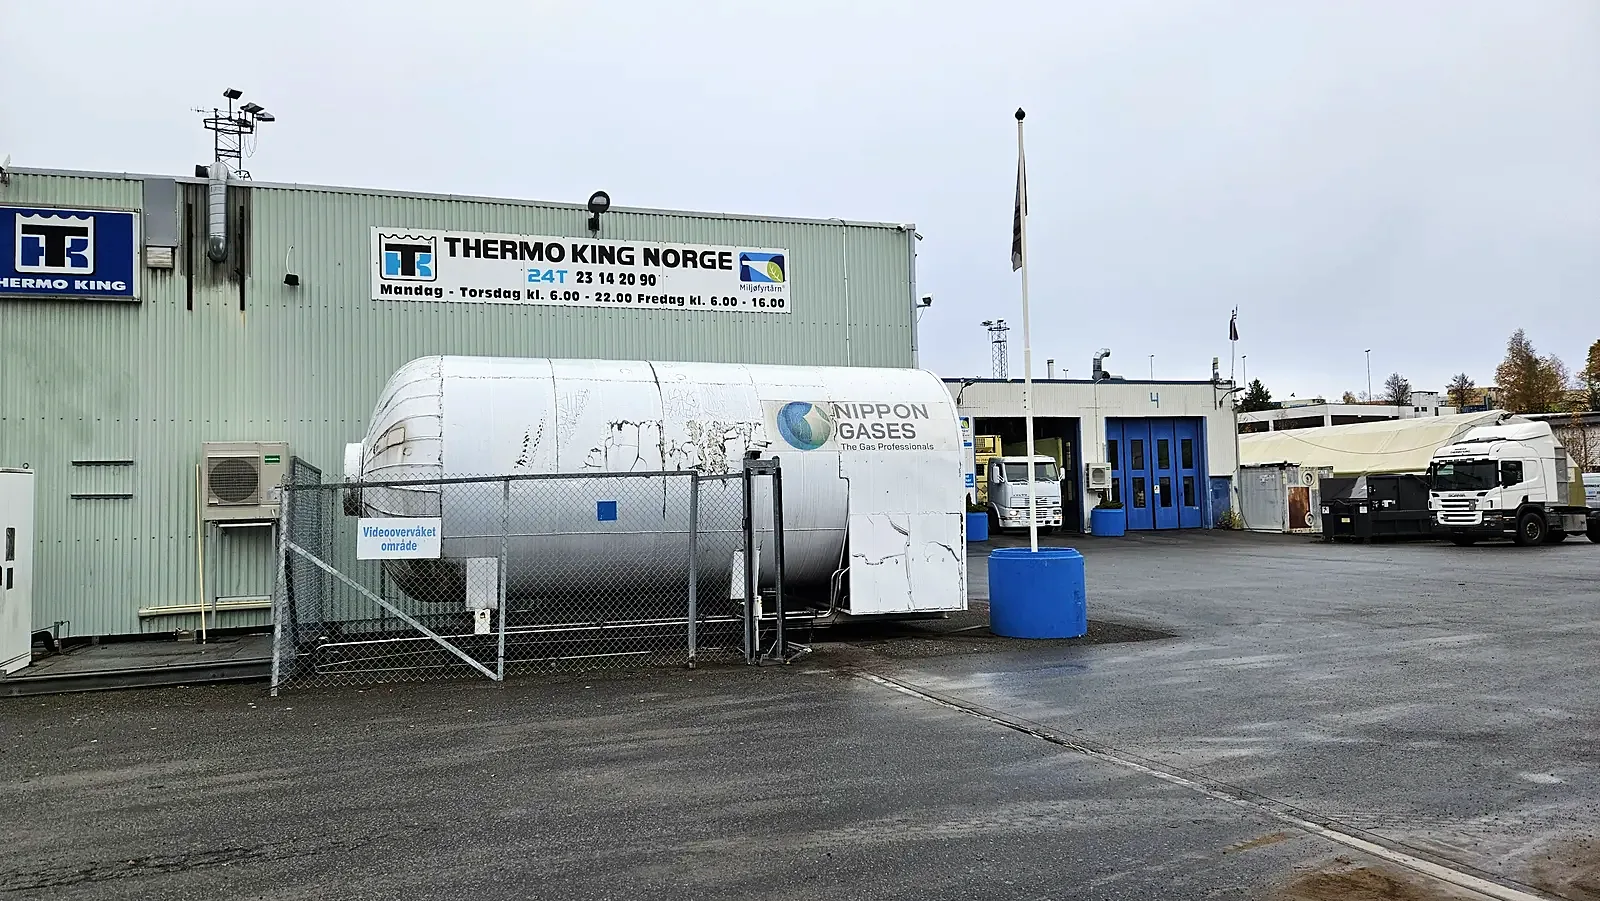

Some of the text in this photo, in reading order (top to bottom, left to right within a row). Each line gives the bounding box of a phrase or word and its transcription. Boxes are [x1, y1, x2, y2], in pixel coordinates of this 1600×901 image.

[444, 237, 733, 271] THERMO KING NORGE
[74, 279, 127, 291] KING
[527, 268, 657, 287] 24T 23 14 20 90
[380, 283, 443, 298] Mandag
[459, 286, 521, 301] Torsdag
[526, 289, 545, 301] kl.
[550, 290, 580, 301] 6.00
[594, 291, 633, 303] 22.00
[637, 293, 685, 306] Fredag
[689, 295, 706, 306] kl.
[710, 296, 738, 307] 6.00
[751, 297, 785, 308] 16.00
[1150, 392, 1159, 409] 4
[833, 403, 930, 420] NIPPON
[839, 422, 917, 440] GASES
[841, 442, 935, 451] The Gas Professionals
[363, 525, 437, 538] Videoovervåket
[381, 539, 418, 551] område
